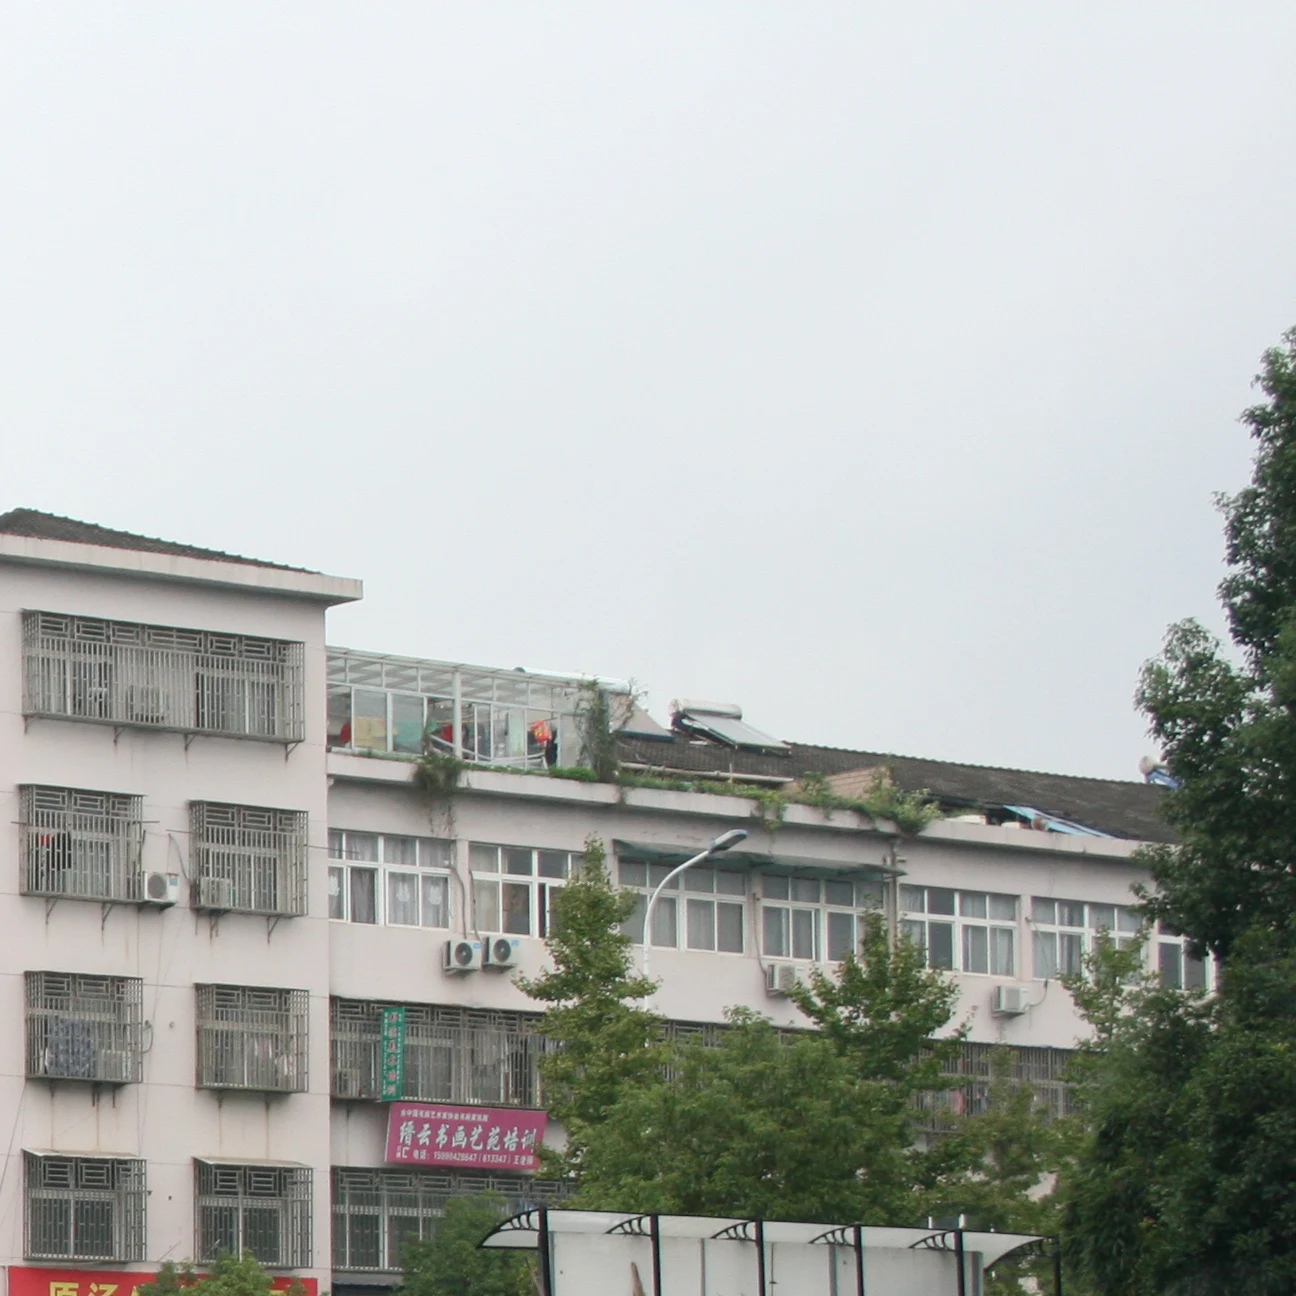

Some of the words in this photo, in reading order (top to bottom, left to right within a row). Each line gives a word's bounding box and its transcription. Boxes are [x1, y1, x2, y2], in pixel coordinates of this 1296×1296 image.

[399, 1121, 537, 1153] 缙云书画艺苑培训
